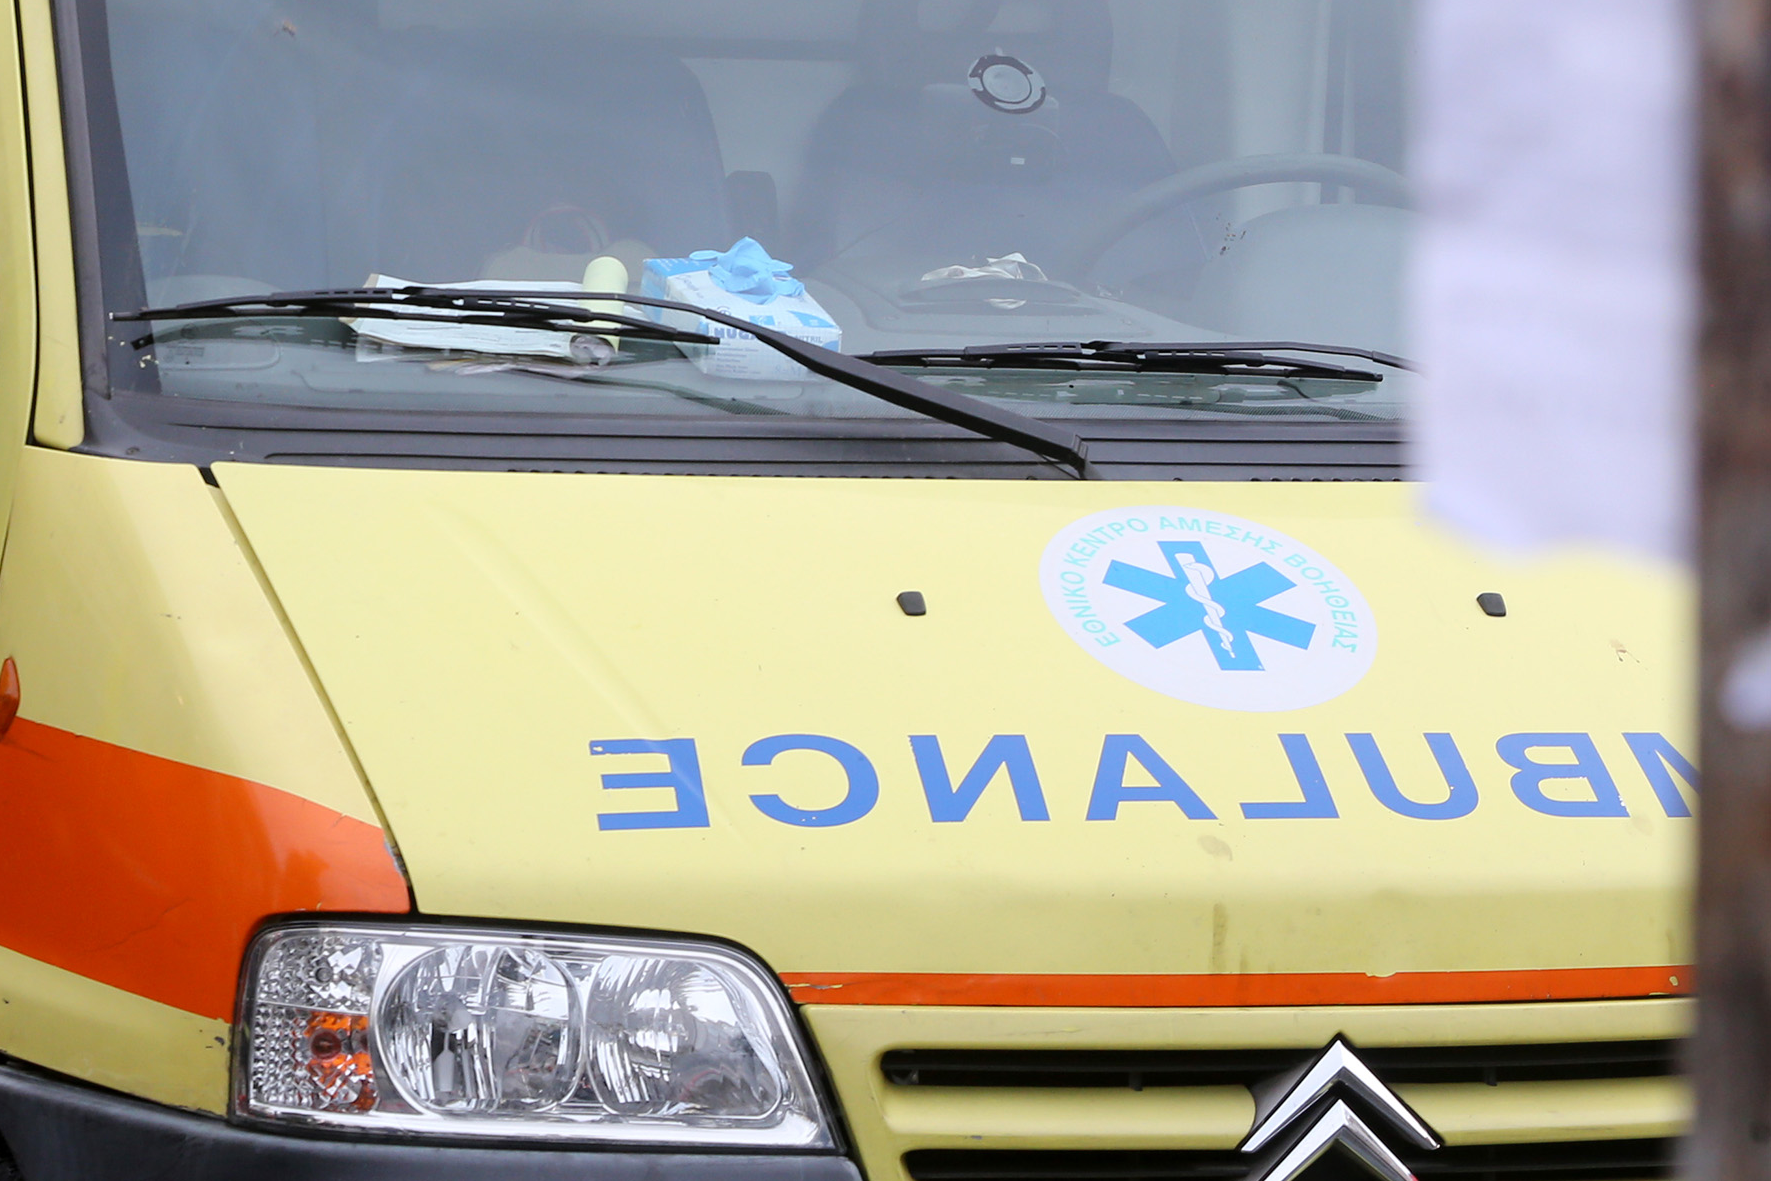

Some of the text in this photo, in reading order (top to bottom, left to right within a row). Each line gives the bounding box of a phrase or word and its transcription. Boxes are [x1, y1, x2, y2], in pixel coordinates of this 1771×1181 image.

[1060, 516, 1359, 653] ΕΘΝΙΚΟ ΚΕΝΤΡΟ ΑΜΕΣΗΣ ΒΟΗΘΕΙΑΣ
